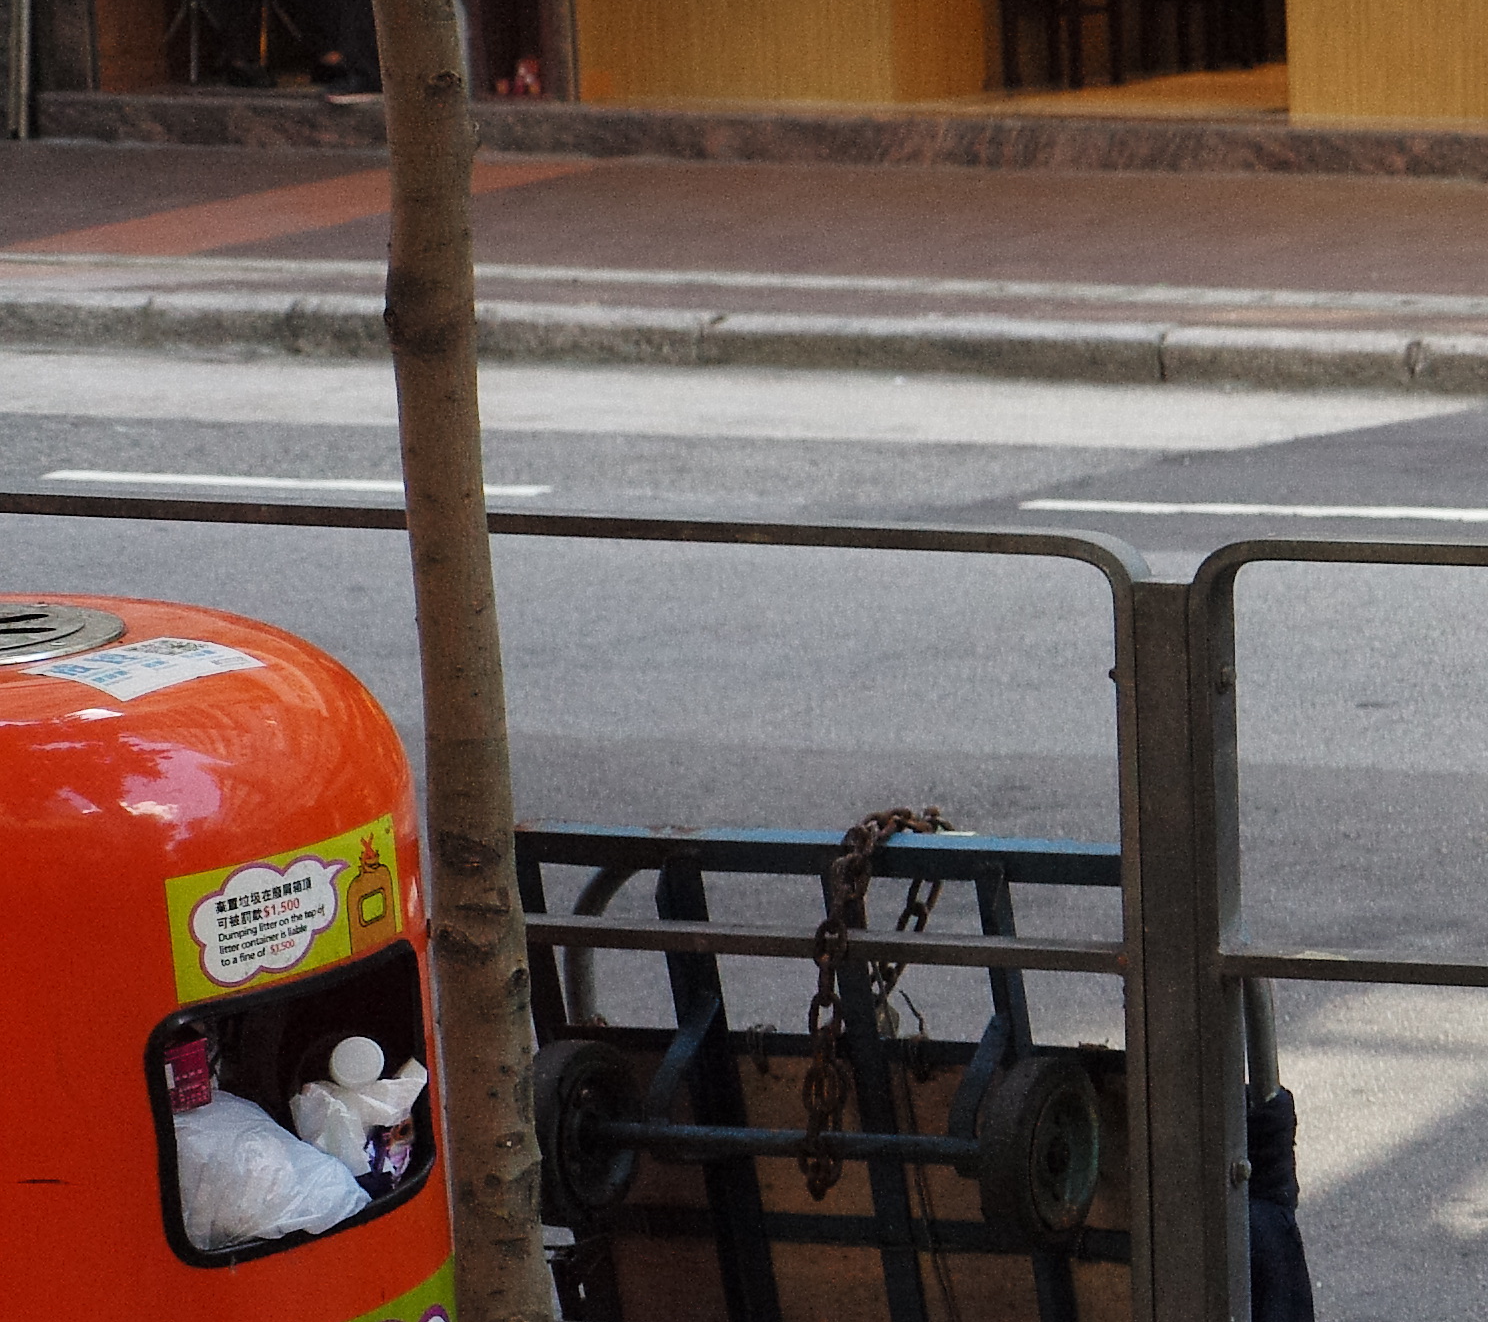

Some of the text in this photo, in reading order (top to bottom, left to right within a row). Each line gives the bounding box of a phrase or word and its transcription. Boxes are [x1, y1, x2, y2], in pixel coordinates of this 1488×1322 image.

[218, 904, 325, 942] Dumping litter on the top of
[219, 924, 308, 955] litter container is liable
[221, 958, 231, 967] to
[240, 952, 256, 963] fine
[257, 947, 266, 958] of
[270, 939, 295, 955] $1,500
